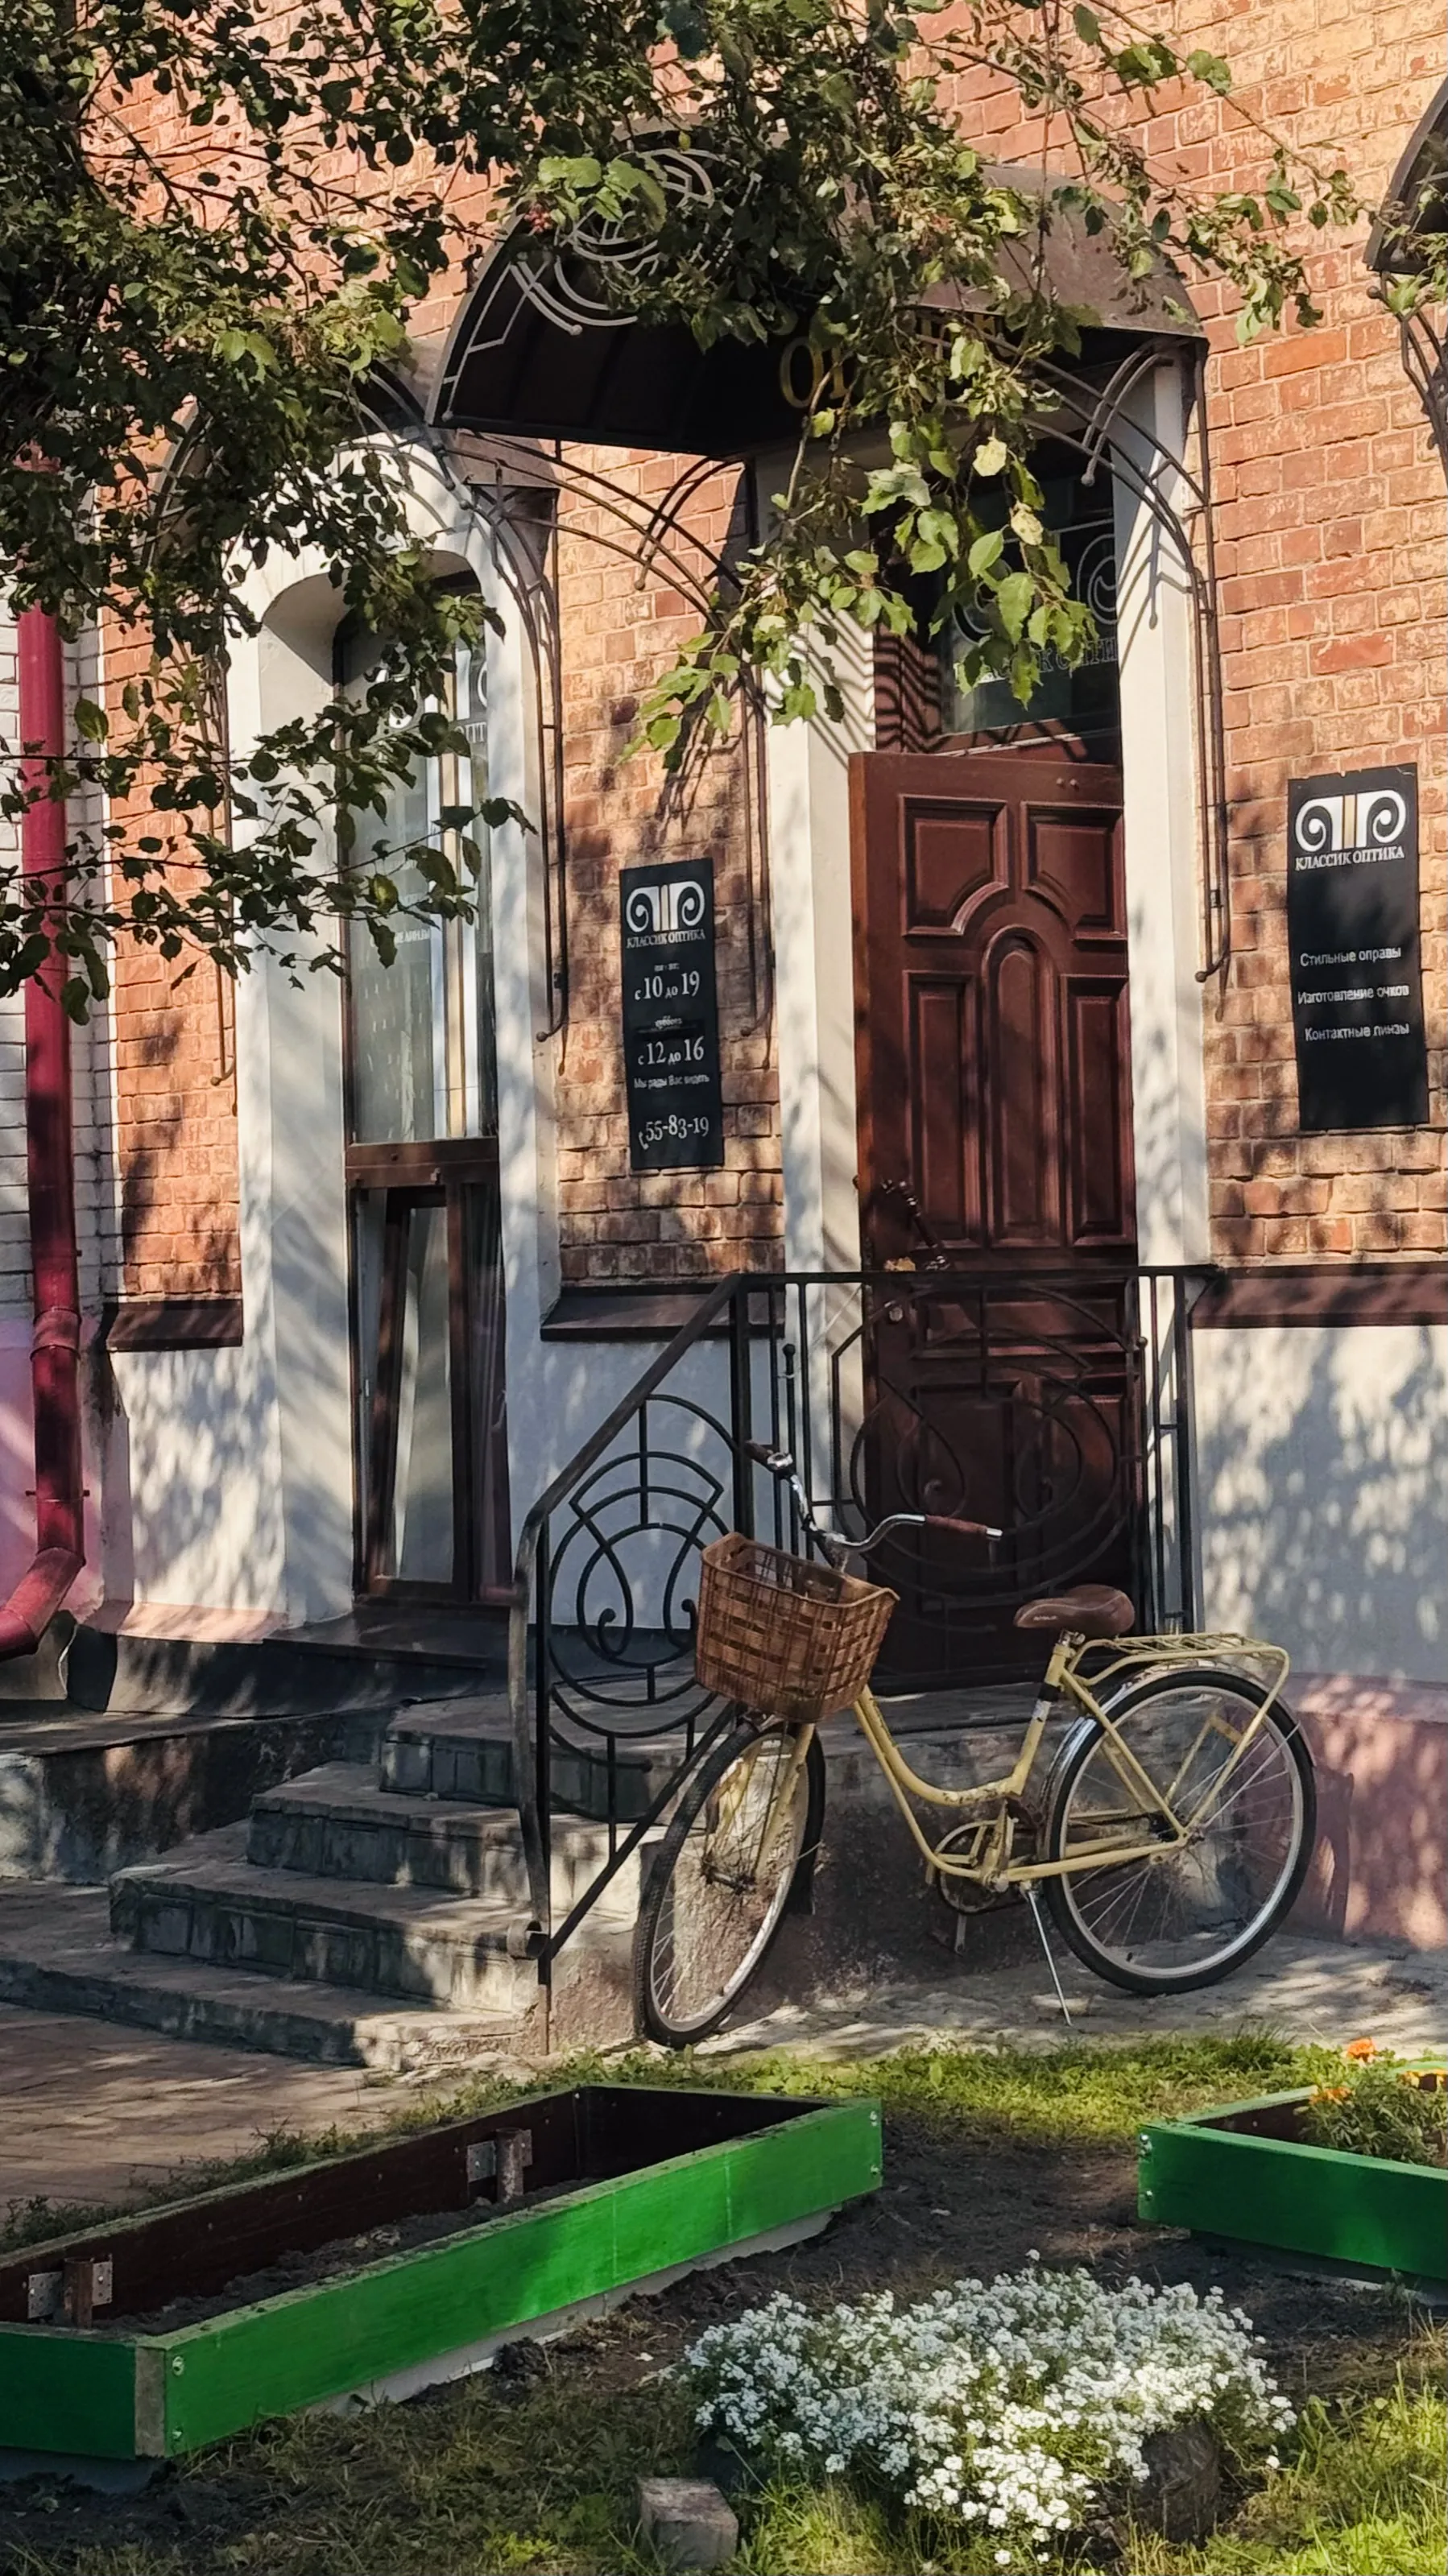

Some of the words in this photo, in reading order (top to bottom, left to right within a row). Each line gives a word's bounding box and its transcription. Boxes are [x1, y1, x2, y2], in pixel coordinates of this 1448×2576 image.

[1295, 852, 1351, 871] КЛАССИК
[1352, 846, 1405, 864] ОПТИКА
[627, 932, 668, 949] КЛАССИК
[668, 928, 706, 944] ОПТИКА
[1300, 951, 1356, 967] Стильные
[1359, 947, 1401, 963] оправы
[643, 976, 663, 1000] 10
[664, 986, 679, 1000] до
[681, 970, 701, 998] 19
[1297, 987, 1374, 1005] Изготовление
[1376, 985, 1409, 998] очков
[1305, 1027, 1371, 1041] Контактные
[1373, 1023, 1409, 1036] линзы
[646, 1040, 667, 1065] 12
[668, 1052, 681, 1066] до
[684, 1036, 704, 1061] 16
[645, 1114, 710, 1142] 55-83-19
